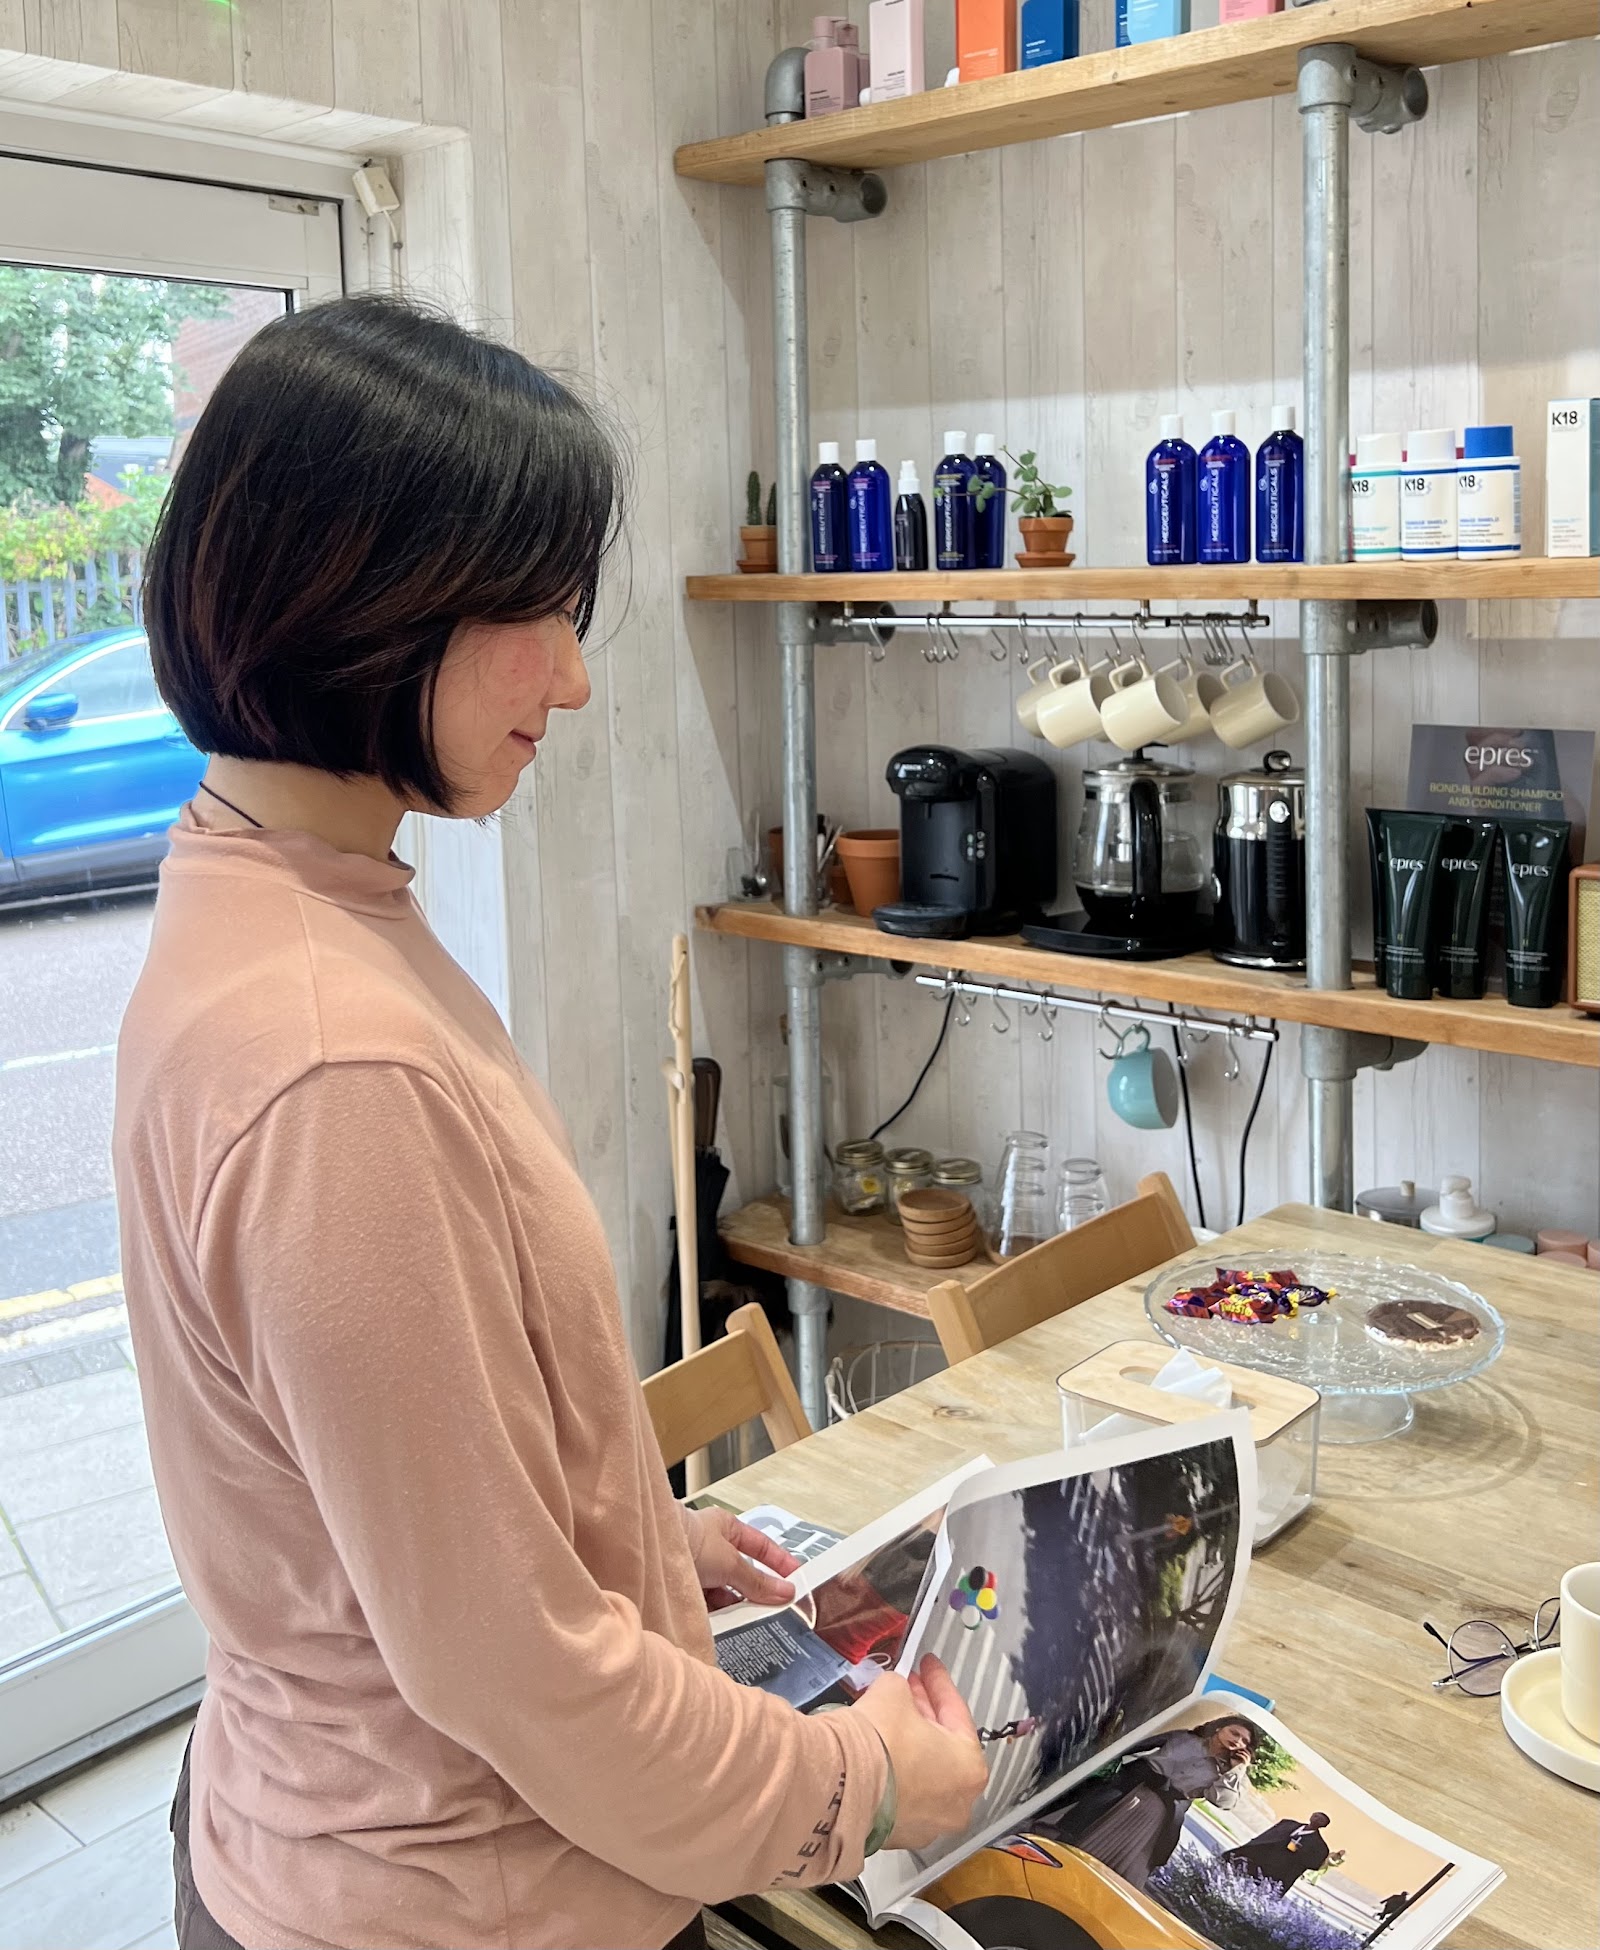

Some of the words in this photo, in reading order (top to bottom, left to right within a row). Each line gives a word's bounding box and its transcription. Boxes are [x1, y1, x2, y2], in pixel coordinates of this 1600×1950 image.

[1552, 410, 1578, 426] K18
[1404, 477, 1425, 492] K18
[1160, 472, 1169, 544] MEDICEUTICALS
[1211, 468, 1220, 542] MEDICEUTICALS
[1270, 467, 1279, 543] MEDICEUTICALS
[1464, 745, 1532, 771] epres
[1429, 782, 1508, 797] BOND-BUILDING
[1510, 788, 1564, 801] SHAMPOO
[1448, 796, 1470, 808] AND
[1471, 799, 1542, 812] CONDITIONER
[1389, 857, 1424, 872] epres
[1441, 857, 1478, 872] epres
[1512, 862, 1549, 878] epres
